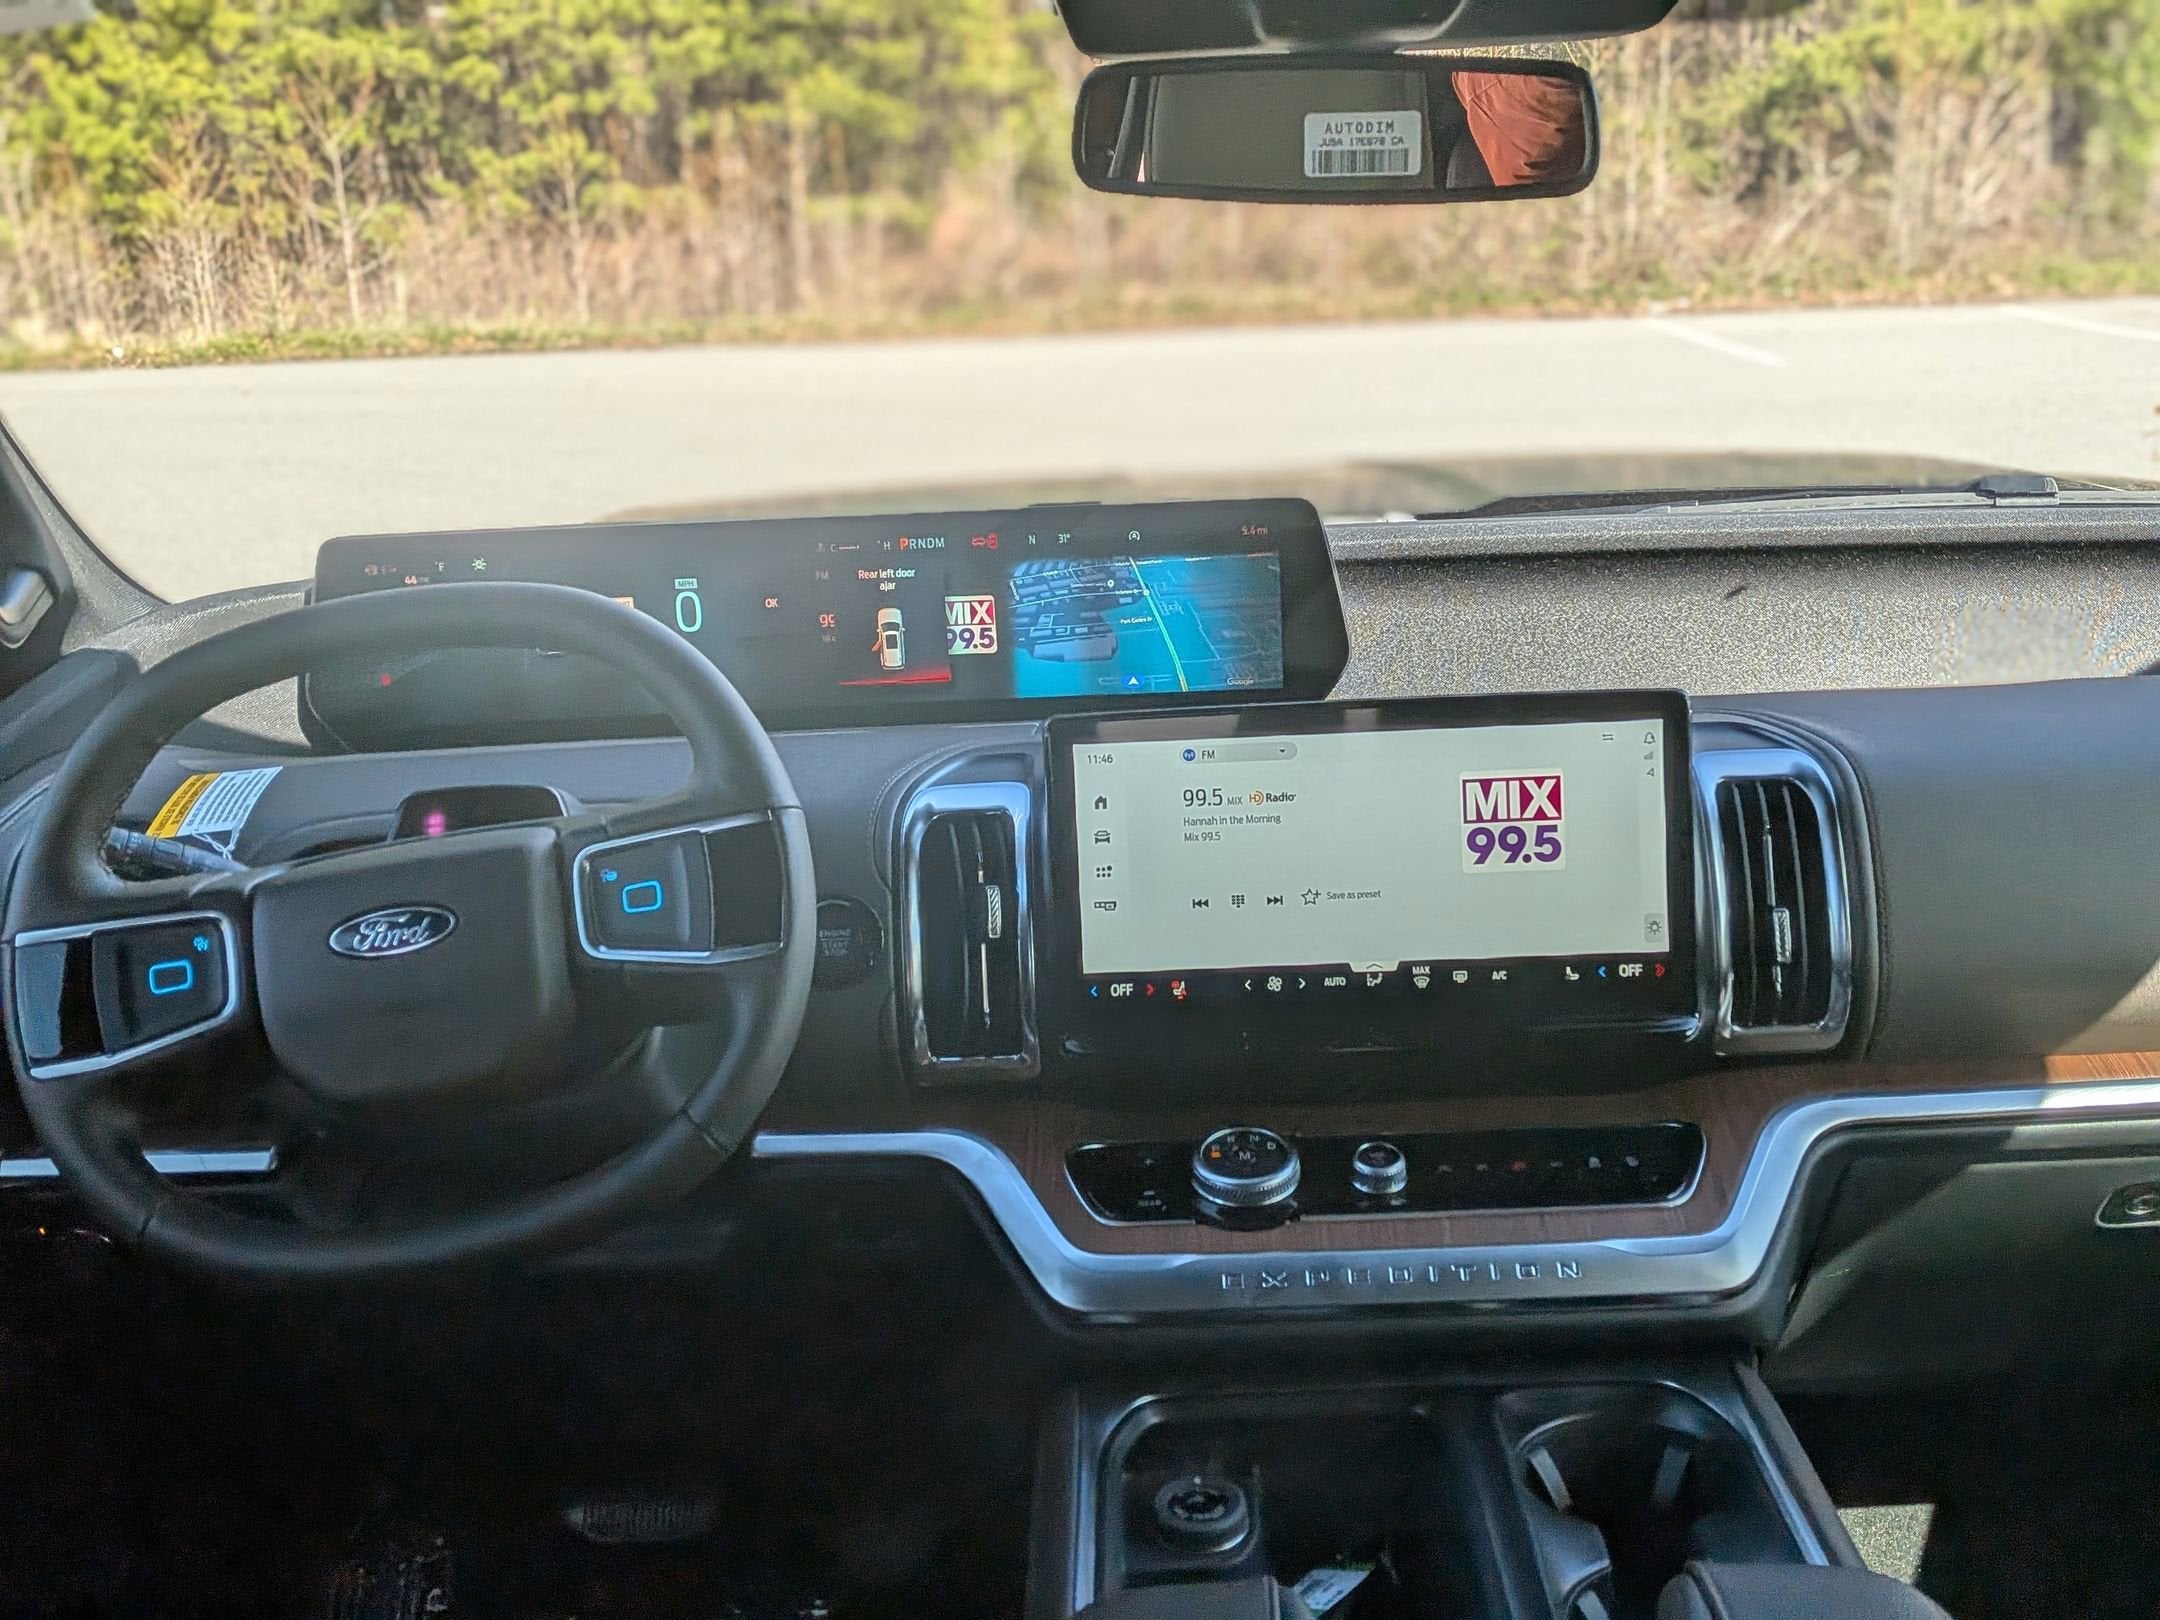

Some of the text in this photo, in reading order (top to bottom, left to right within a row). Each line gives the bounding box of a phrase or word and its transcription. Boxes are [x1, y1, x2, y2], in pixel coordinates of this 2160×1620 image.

[1324, 121, 1395, 134] AUTODIM
[1027, 534, 1036, 545] N
[858, 567, 916, 579] Rear left door
[879, 581, 896, 592] ajar
[765, 598, 778, 608] OK
[675, 591, 702, 632] 0
[1087, 754, 1113, 764] 11:46
[1201, 750, 1215, 759] FM
[1183, 788, 1223, 807] 99.5
[1227, 796, 1243, 805] MIX
[1464, 777, 1560, 821] MIX
[1183, 814, 1281, 827] Hannah in the Morning
[1184, 831, 1221, 842] Mix 99.5
[1466, 825, 1562, 865] 99.5
[1327, 891, 1345, 900] Save
[1357, 890, 1381, 900] preset
[353, 914, 431, 950] Ford
[1412, 966, 1431, 975] MAX
[1492, 970, 1507, 980] A/C
[1618, 964, 1643, 978] OFF
[1324, 977, 1346, 987] AUTO
[1110, 983, 1134, 997] OFF
[1221, 1261, 1582, 1290] EXPEDITION
